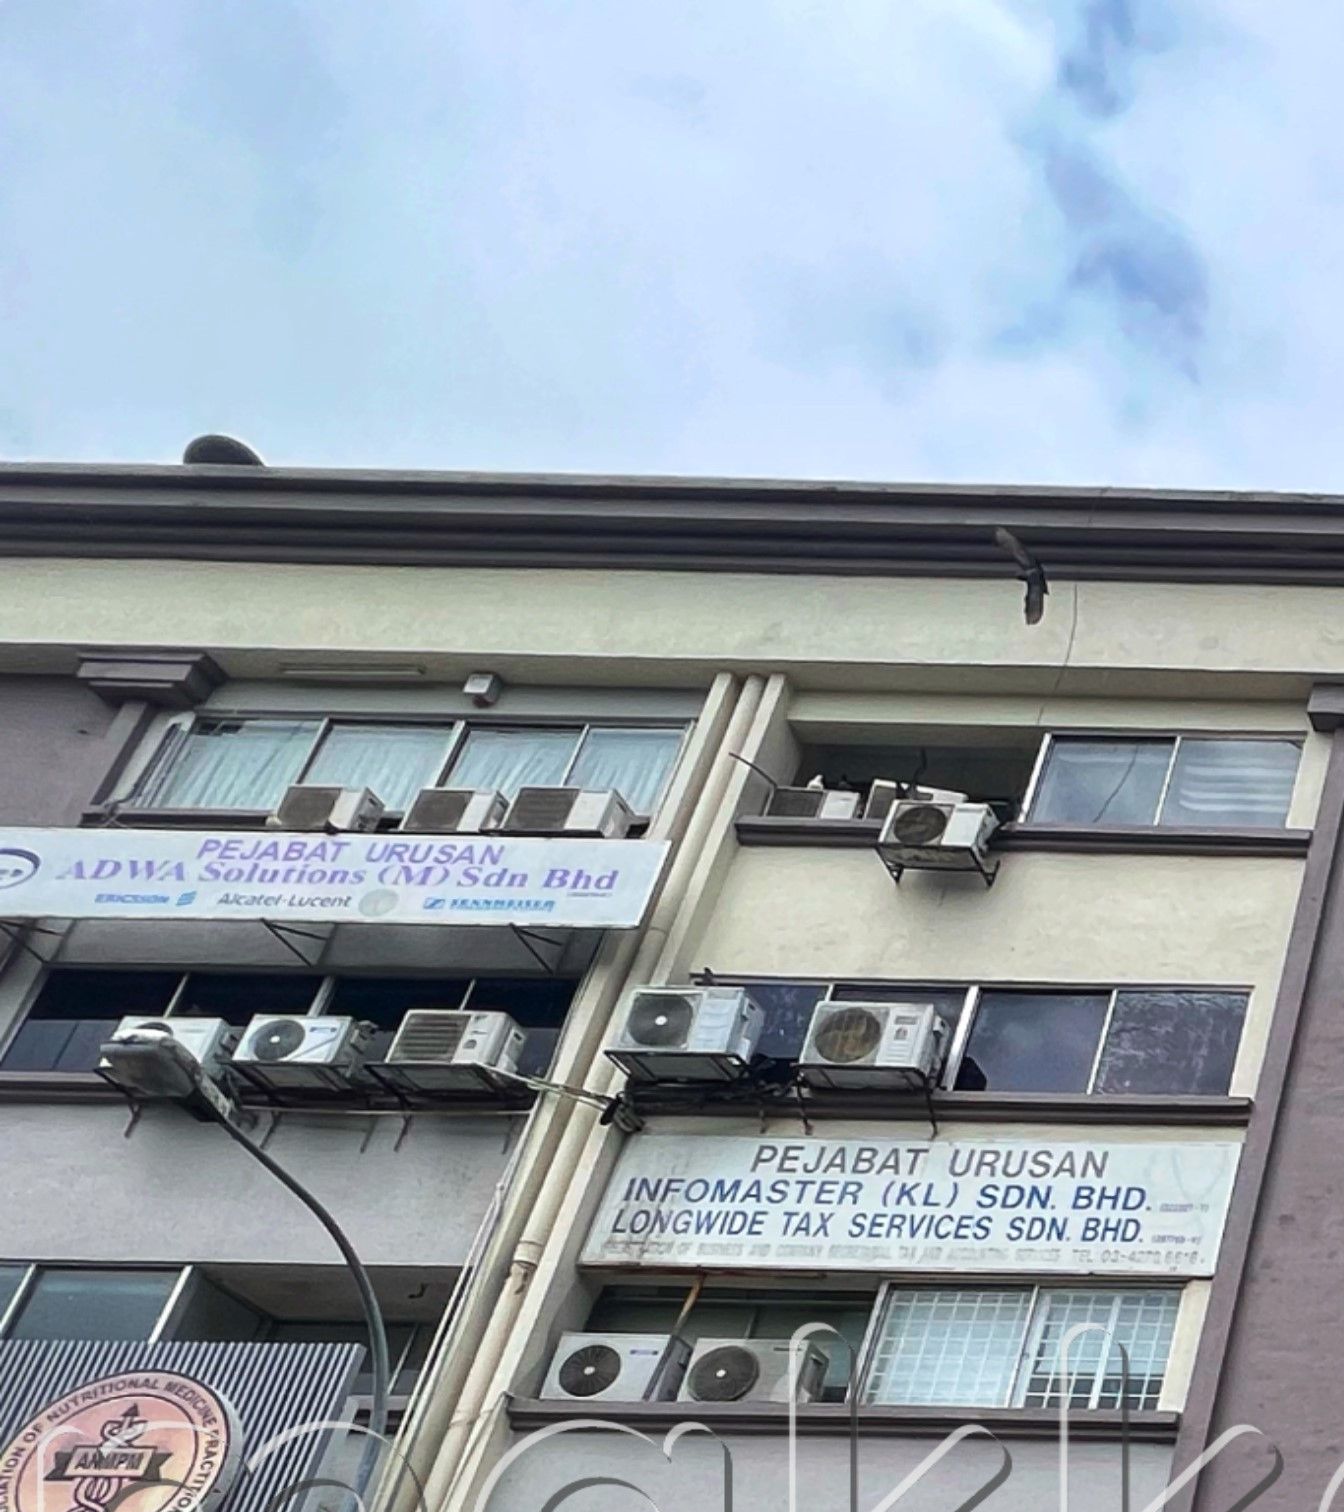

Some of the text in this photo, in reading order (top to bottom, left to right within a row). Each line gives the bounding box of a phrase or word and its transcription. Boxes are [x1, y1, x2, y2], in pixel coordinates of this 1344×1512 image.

[196, 839, 505, 866] PEJABAT URUSAN
[55, 859, 619, 892] ADWA Solutions (M) Sdn Bhd
[749, 1145, 1110, 1179] PEJABAT URUSAN
[623, 1178, 1152, 1212] INFOMASTER (KL) SDN. BHD.
[611, 1210, 768, 1236] LONGWIDE
[781, 1212, 835, 1238] TAX
[847, 1213, 993, 1240] SERVICES
[1005, 1215, 1072, 1242] SDN.
[1080, 1217, 1144, 1244] BHD.
[22, 1421, 44, 1444] OF
[46, 1378, 159, 1423] NUTRITIONAL
[164, 1381, 218, 1430] MEDICINE
